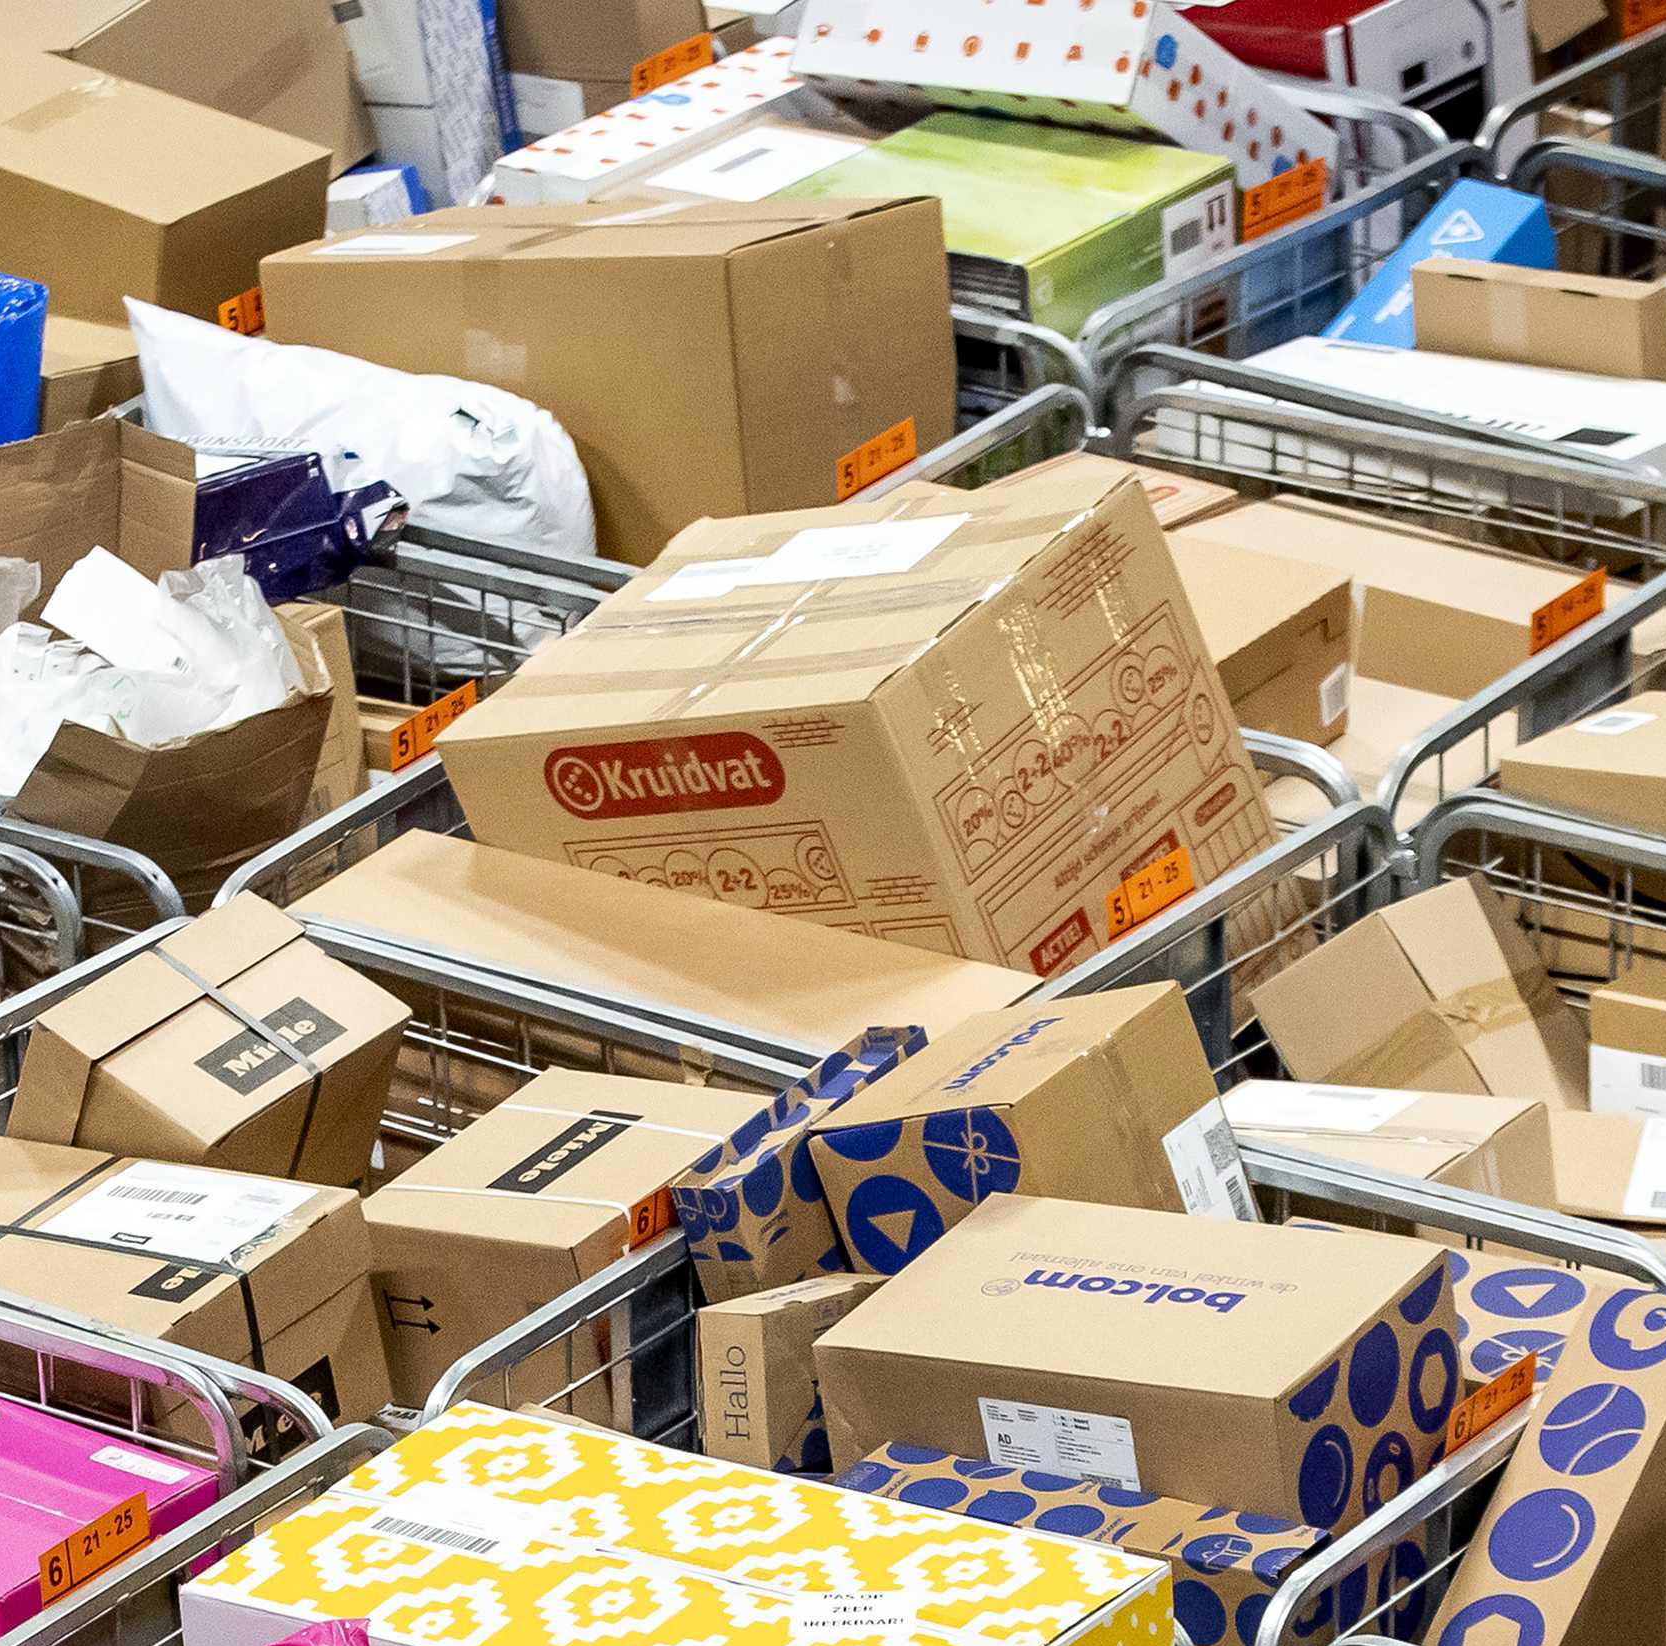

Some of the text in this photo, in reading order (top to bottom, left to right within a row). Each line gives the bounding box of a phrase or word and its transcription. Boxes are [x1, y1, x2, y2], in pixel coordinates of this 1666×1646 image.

[425, 695, 466, 734] 21 25
[398, 732, 409, 757] 5
[597, 753, 772, 801] Kruidvat
[1138, 862, 1180, 899] 21 25
[1114, 898, 1125, 924] 5
[517, 1121, 614, 1184] Miele
[637, 1206, 650, 1234] 6
[1023, 1269, 1247, 1313] bol.com
[725, 1345, 750, 1441] Hallo
[1484, 1367, 1526, 1410] 21 25
[998, 1433, 1012, 1445] AD
[1454, 1414, 1467, 1441] 6
[83, 1509, 133, 1557] 21 25
[48, 1558, 63, 1586] 6
